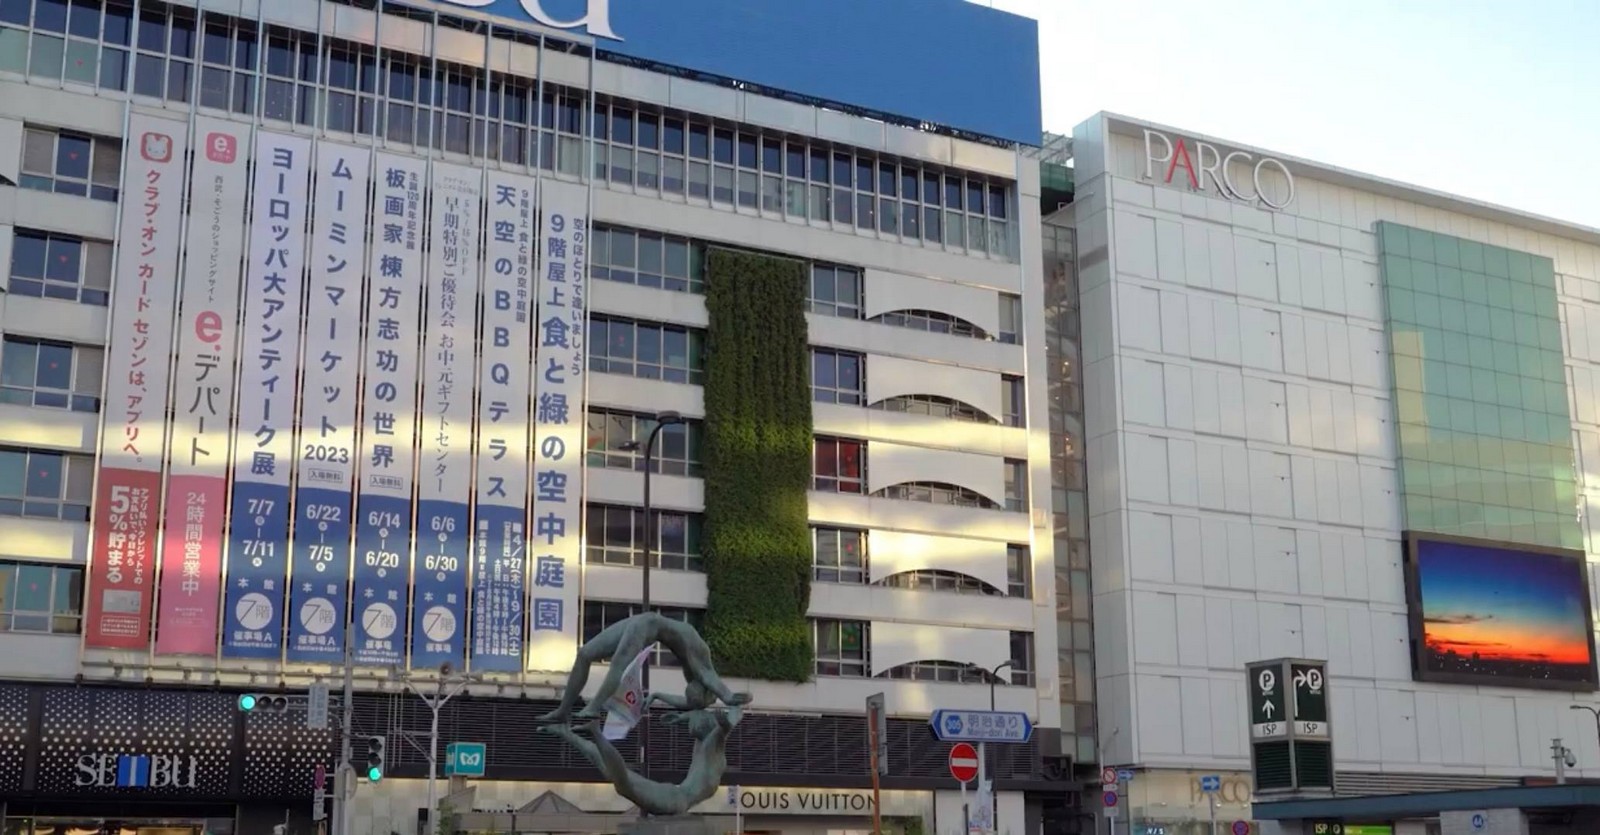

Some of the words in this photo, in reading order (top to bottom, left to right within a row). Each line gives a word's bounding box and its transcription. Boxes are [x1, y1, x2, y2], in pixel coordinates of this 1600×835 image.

[1143, 129, 1294, 209] PARCO
[320, 158, 353, 437] ムーミンマーケット
[251, 147, 293, 476] ヨーロッパ大アンティーク展
[487, 184, 517, 498] 天空のBBQテラス
[534, 213, 570, 632] 9階屋上食と緑の空中庭園
[304, 444, 349, 464] 2023
[248, 499, 274, 516] 7/7
[306, 504, 341, 521] 6/22
[368, 511, 401, 528] 6/14
[431, 516, 455, 532] 6/6
[106, 485, 130, 584] 5%貯まる
[181, 492, 206, 597] 24時間営業中
[242, 540, 274, 557] 7/11
[309, 545, 334, 562] 7/5
[366, 551, 399, 567] 6/20
[425, 555, 458, 572] 6/30
[968, 714, 1018, 728] 明治通り
[1262, 723, 1277, 735] ISP
[1303, 722, 1318, 734] ISP
[75, 753, 198, 788] SEIBU
